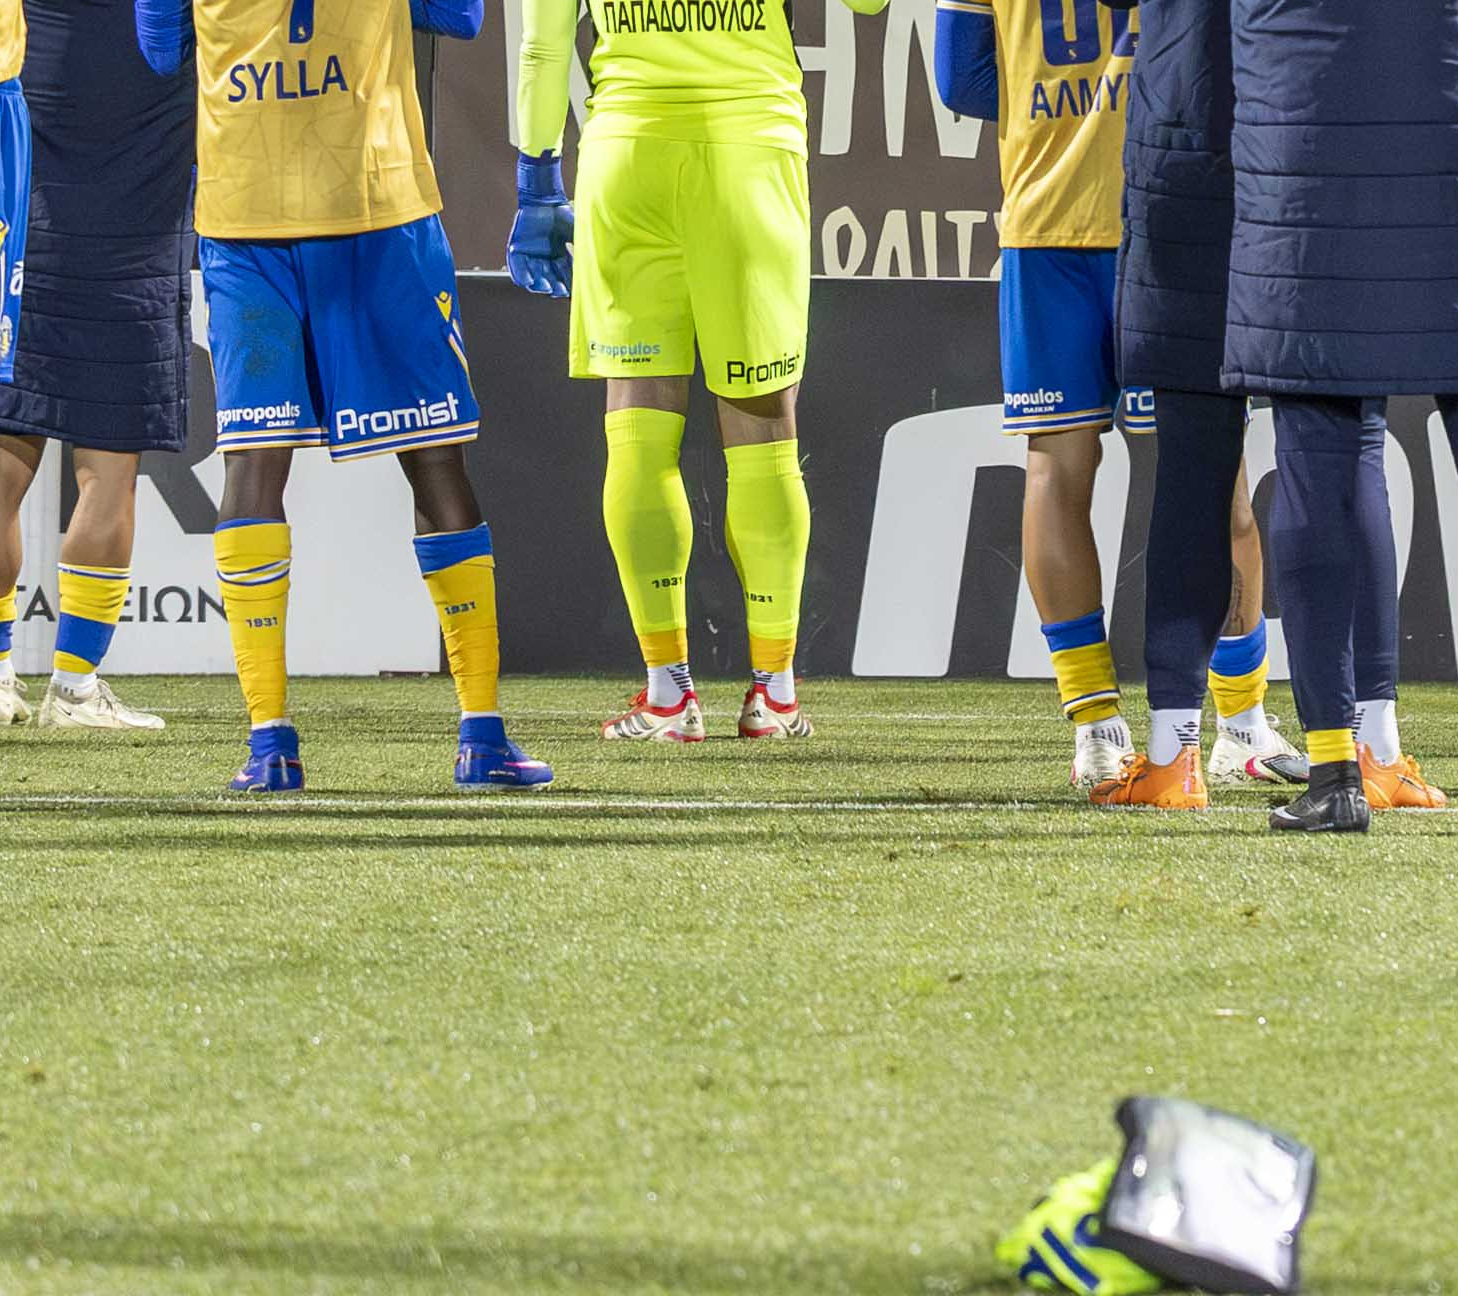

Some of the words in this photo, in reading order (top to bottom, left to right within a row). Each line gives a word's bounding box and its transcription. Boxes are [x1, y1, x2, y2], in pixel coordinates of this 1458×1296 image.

[227, 55, 349, 104] SYLLA
[726, 352, 800, 384] Promis
[335, 392, 459, 440] Promist
[651, 576, 684, 589] 1931
[444, 600, 476, 615] 1931
[245, 617, 279, 628] 1931
